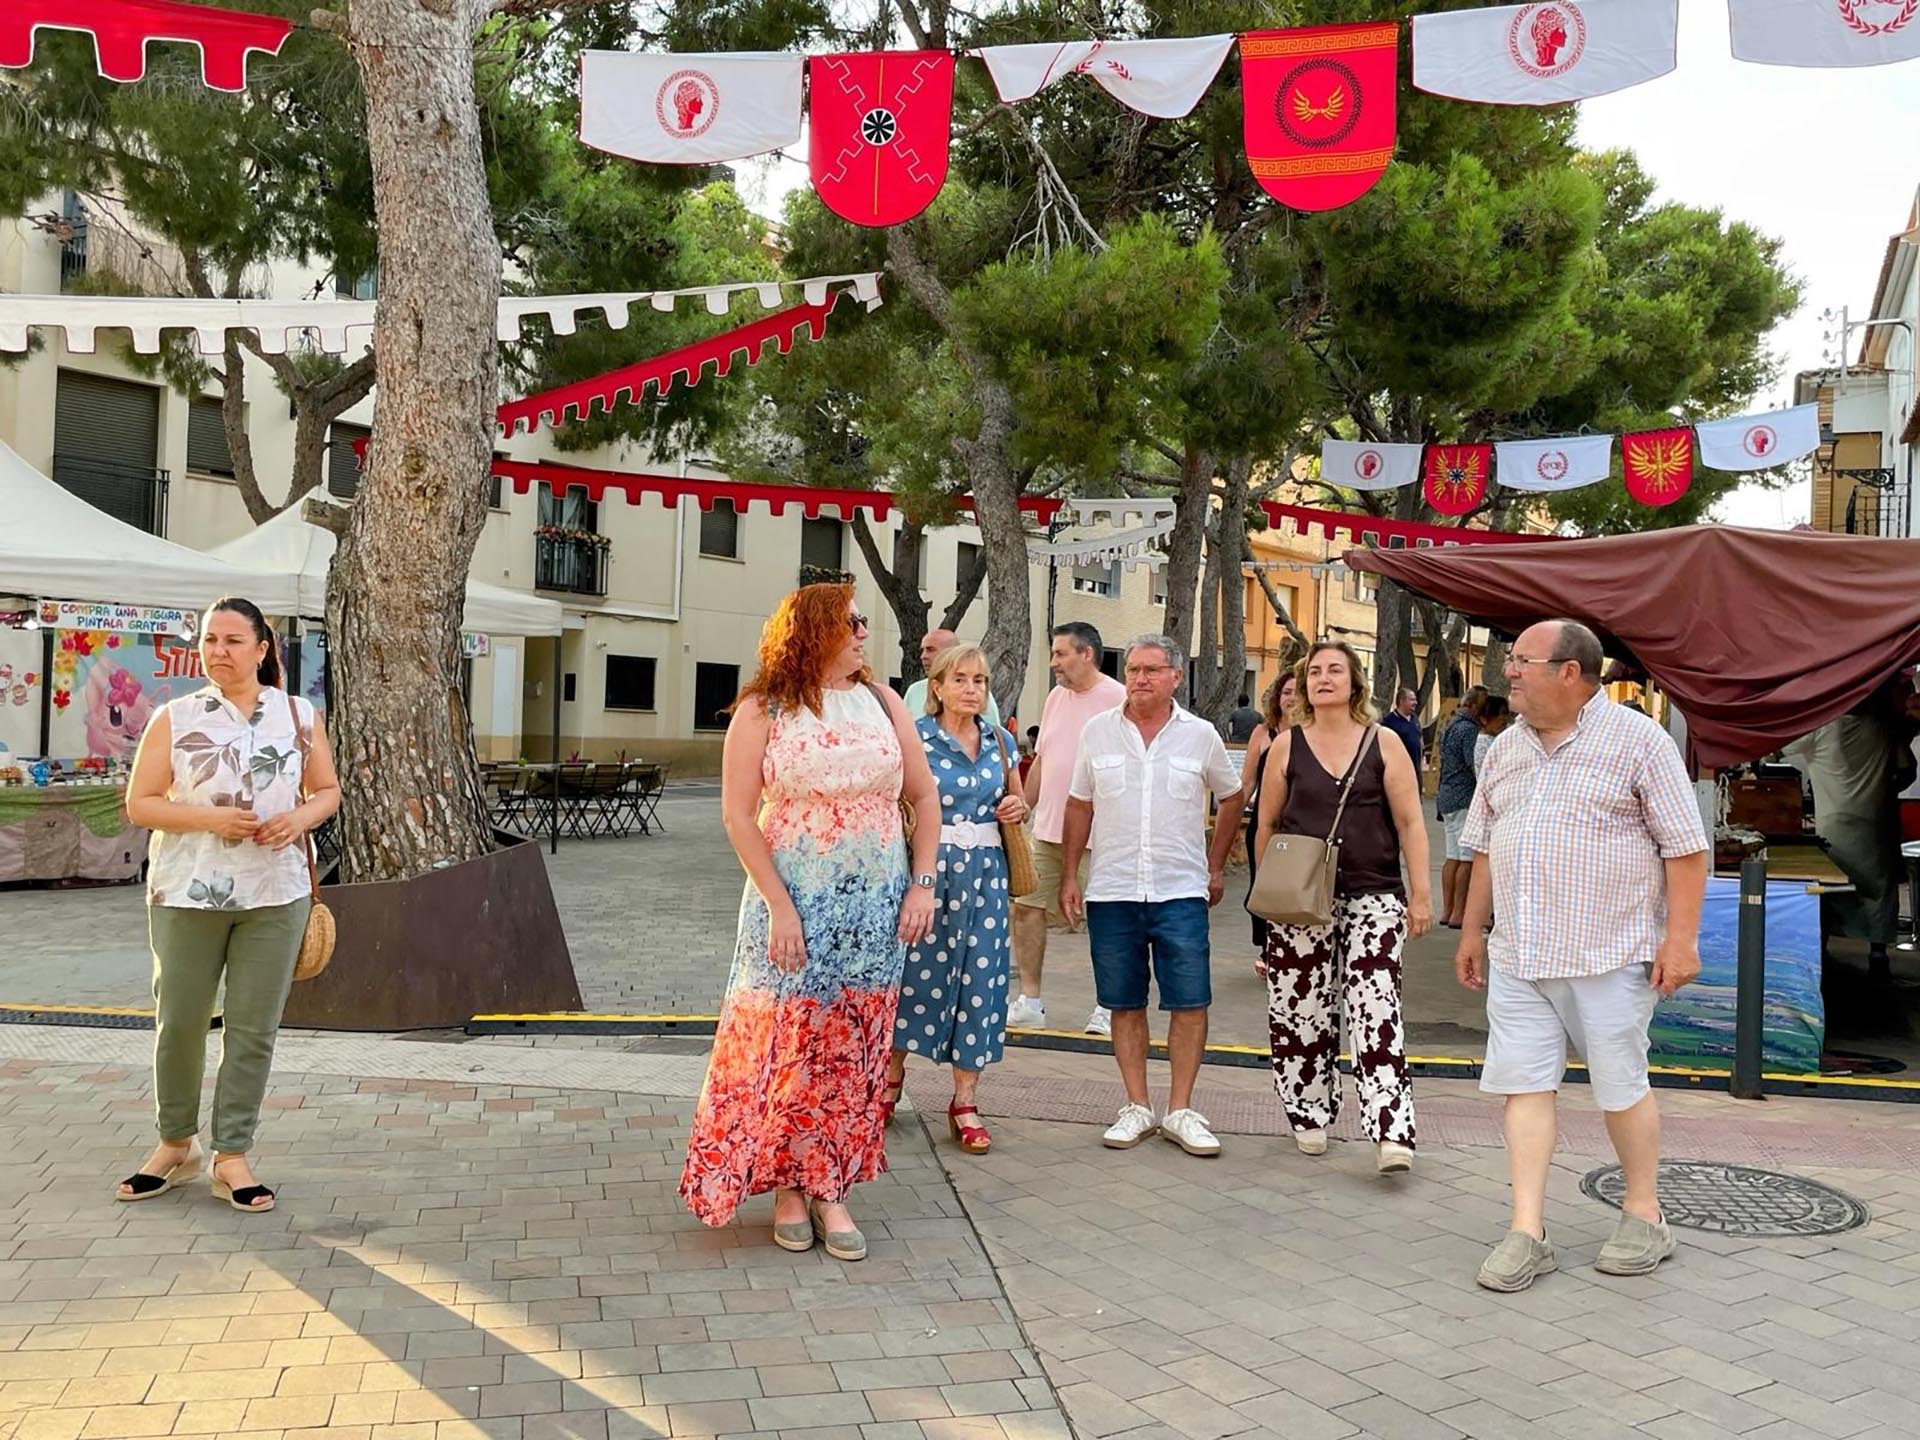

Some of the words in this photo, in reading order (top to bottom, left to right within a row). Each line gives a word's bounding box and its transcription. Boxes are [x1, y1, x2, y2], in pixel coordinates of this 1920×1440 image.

[61, 604, 110, 616] COMPRA
[115, 608, 138, 618] UNA
[143, 610, 182, 621] FIGURA
[77, 616, 123, 629] PINTALA
[128, 620, 168, 632] GRATIS
